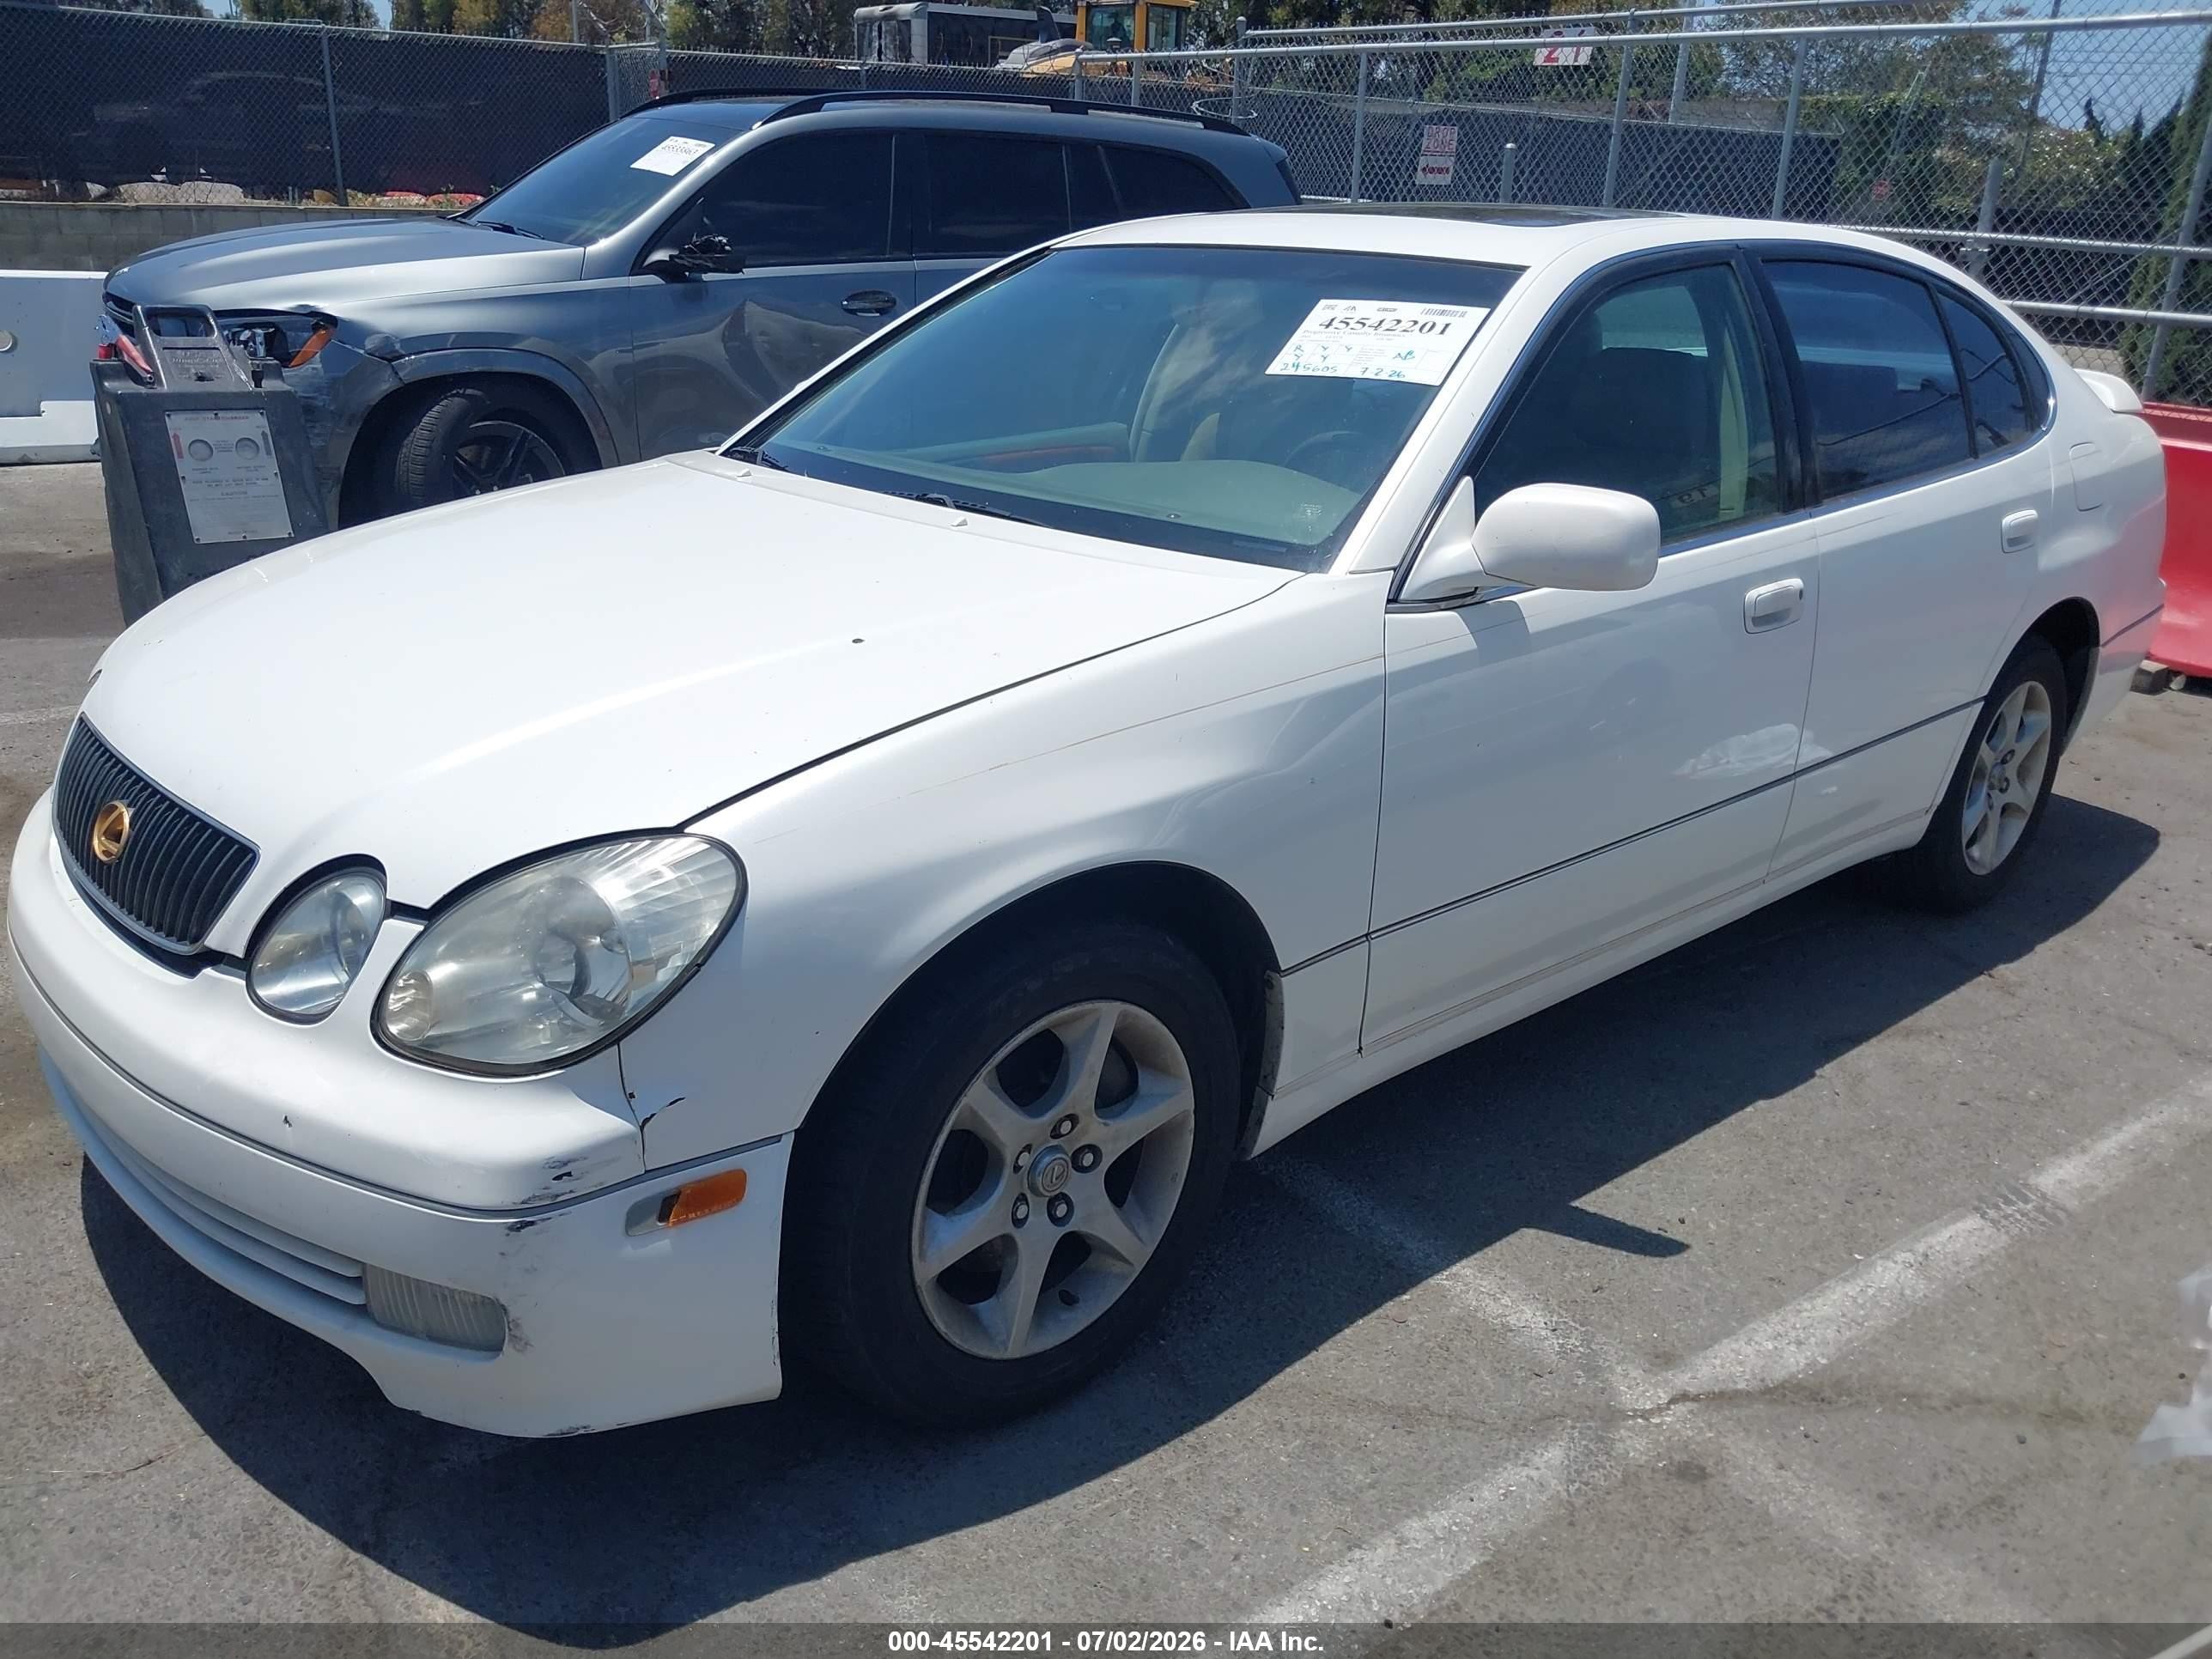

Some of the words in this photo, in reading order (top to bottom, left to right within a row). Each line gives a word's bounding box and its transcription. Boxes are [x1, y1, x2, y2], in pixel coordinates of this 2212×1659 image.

[1428, 126, 1456, 138] DROP
[1425, 138, 1455, 151] ZONE
[1319, 316, 1452, 336] 45542201
